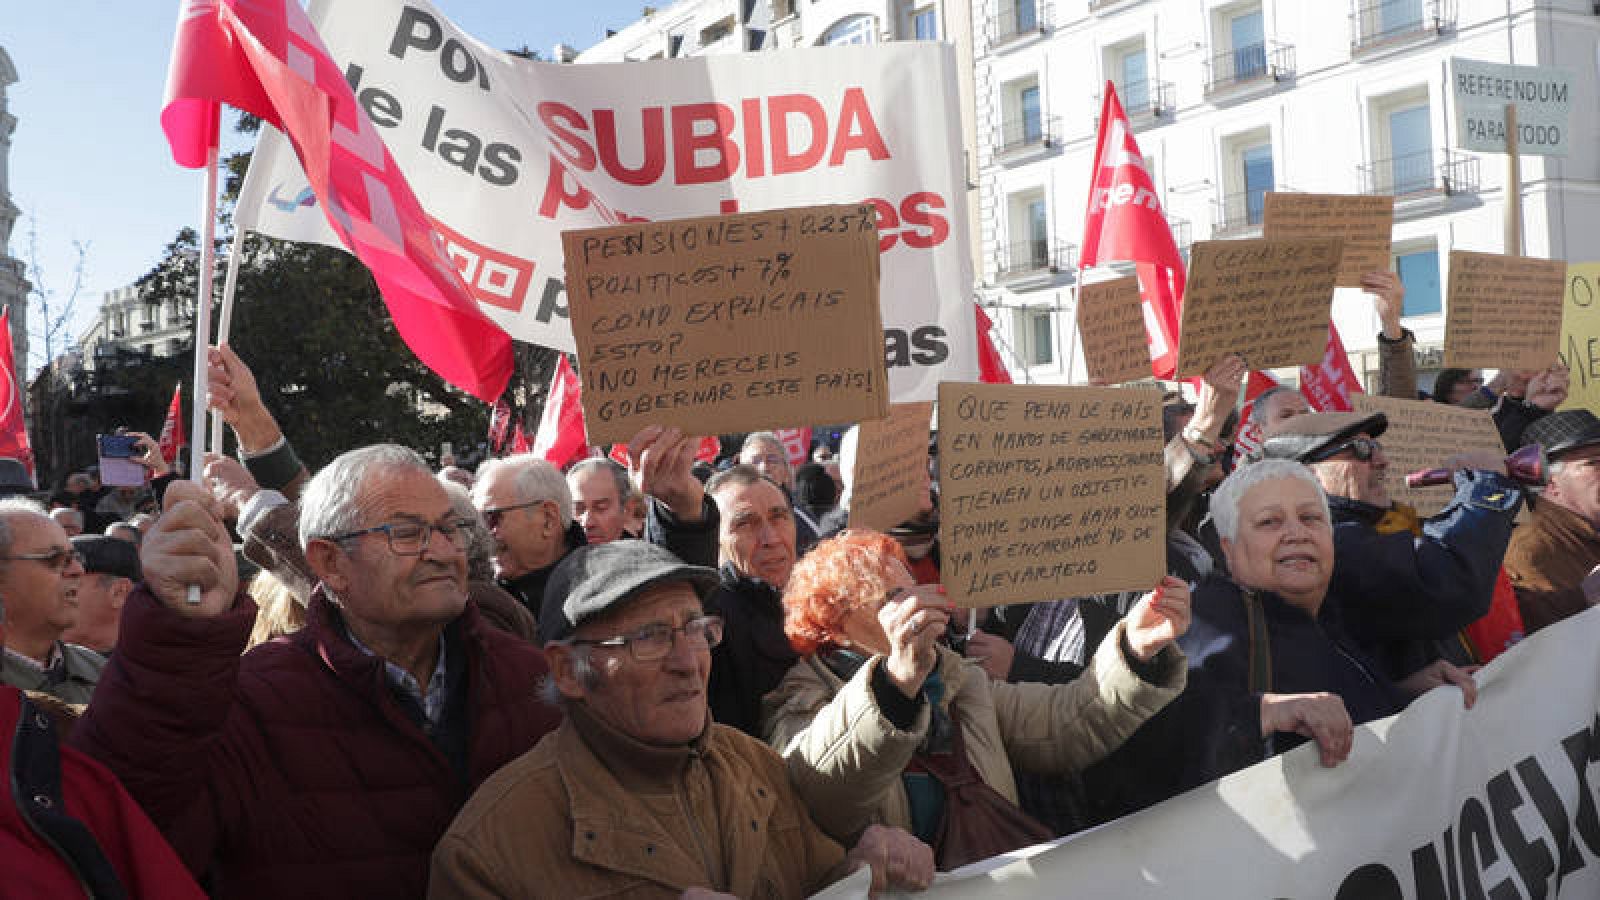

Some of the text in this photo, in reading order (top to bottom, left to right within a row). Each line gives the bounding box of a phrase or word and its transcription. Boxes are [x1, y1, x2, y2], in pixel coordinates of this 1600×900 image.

[1457, 73, 1569, 103] REFERENDUM
[421, 105, 523, 186] las
[537, 87, 891, 186] SUBIDA
[1466, 118, 1506, 140] PARA
[583, 221, 770, 265] PENSIONES
[586, 265, 724, 299] POLITICOS
[591, 291, 844, 335] COMO EXPLICAIS
[590, 332, 684, 363] ESTO?
[653, 352, 799, 390] MERECEIS
[599, 383, 736, 422] GOBERNAR
[747, 378, 801, 398] ESTE
[957, 394, 1009, 422] QUE
[1024, 400, 1071, 421] PENA
[1080, 401, 1101, 419] DE
[952, 431, 981, 451] EN
[991, 430, 1045, 456] MANOS
[1050, 432, 1072, 446] DE
[952, 473, 1148, 516] TIENEN UN OBJETIVO
[1018, 512, 1073, 532] DONDE
[1080, 506, 1121, 528] HAYA
[1125, 503, 1163, 520] QUE
[950, 551, 973, 577] YA
[980, 545, 1001, 566] ME
[1133, 526, 1153, 541] DE
[966, 559, 1098, 596] LLEVARMELO
